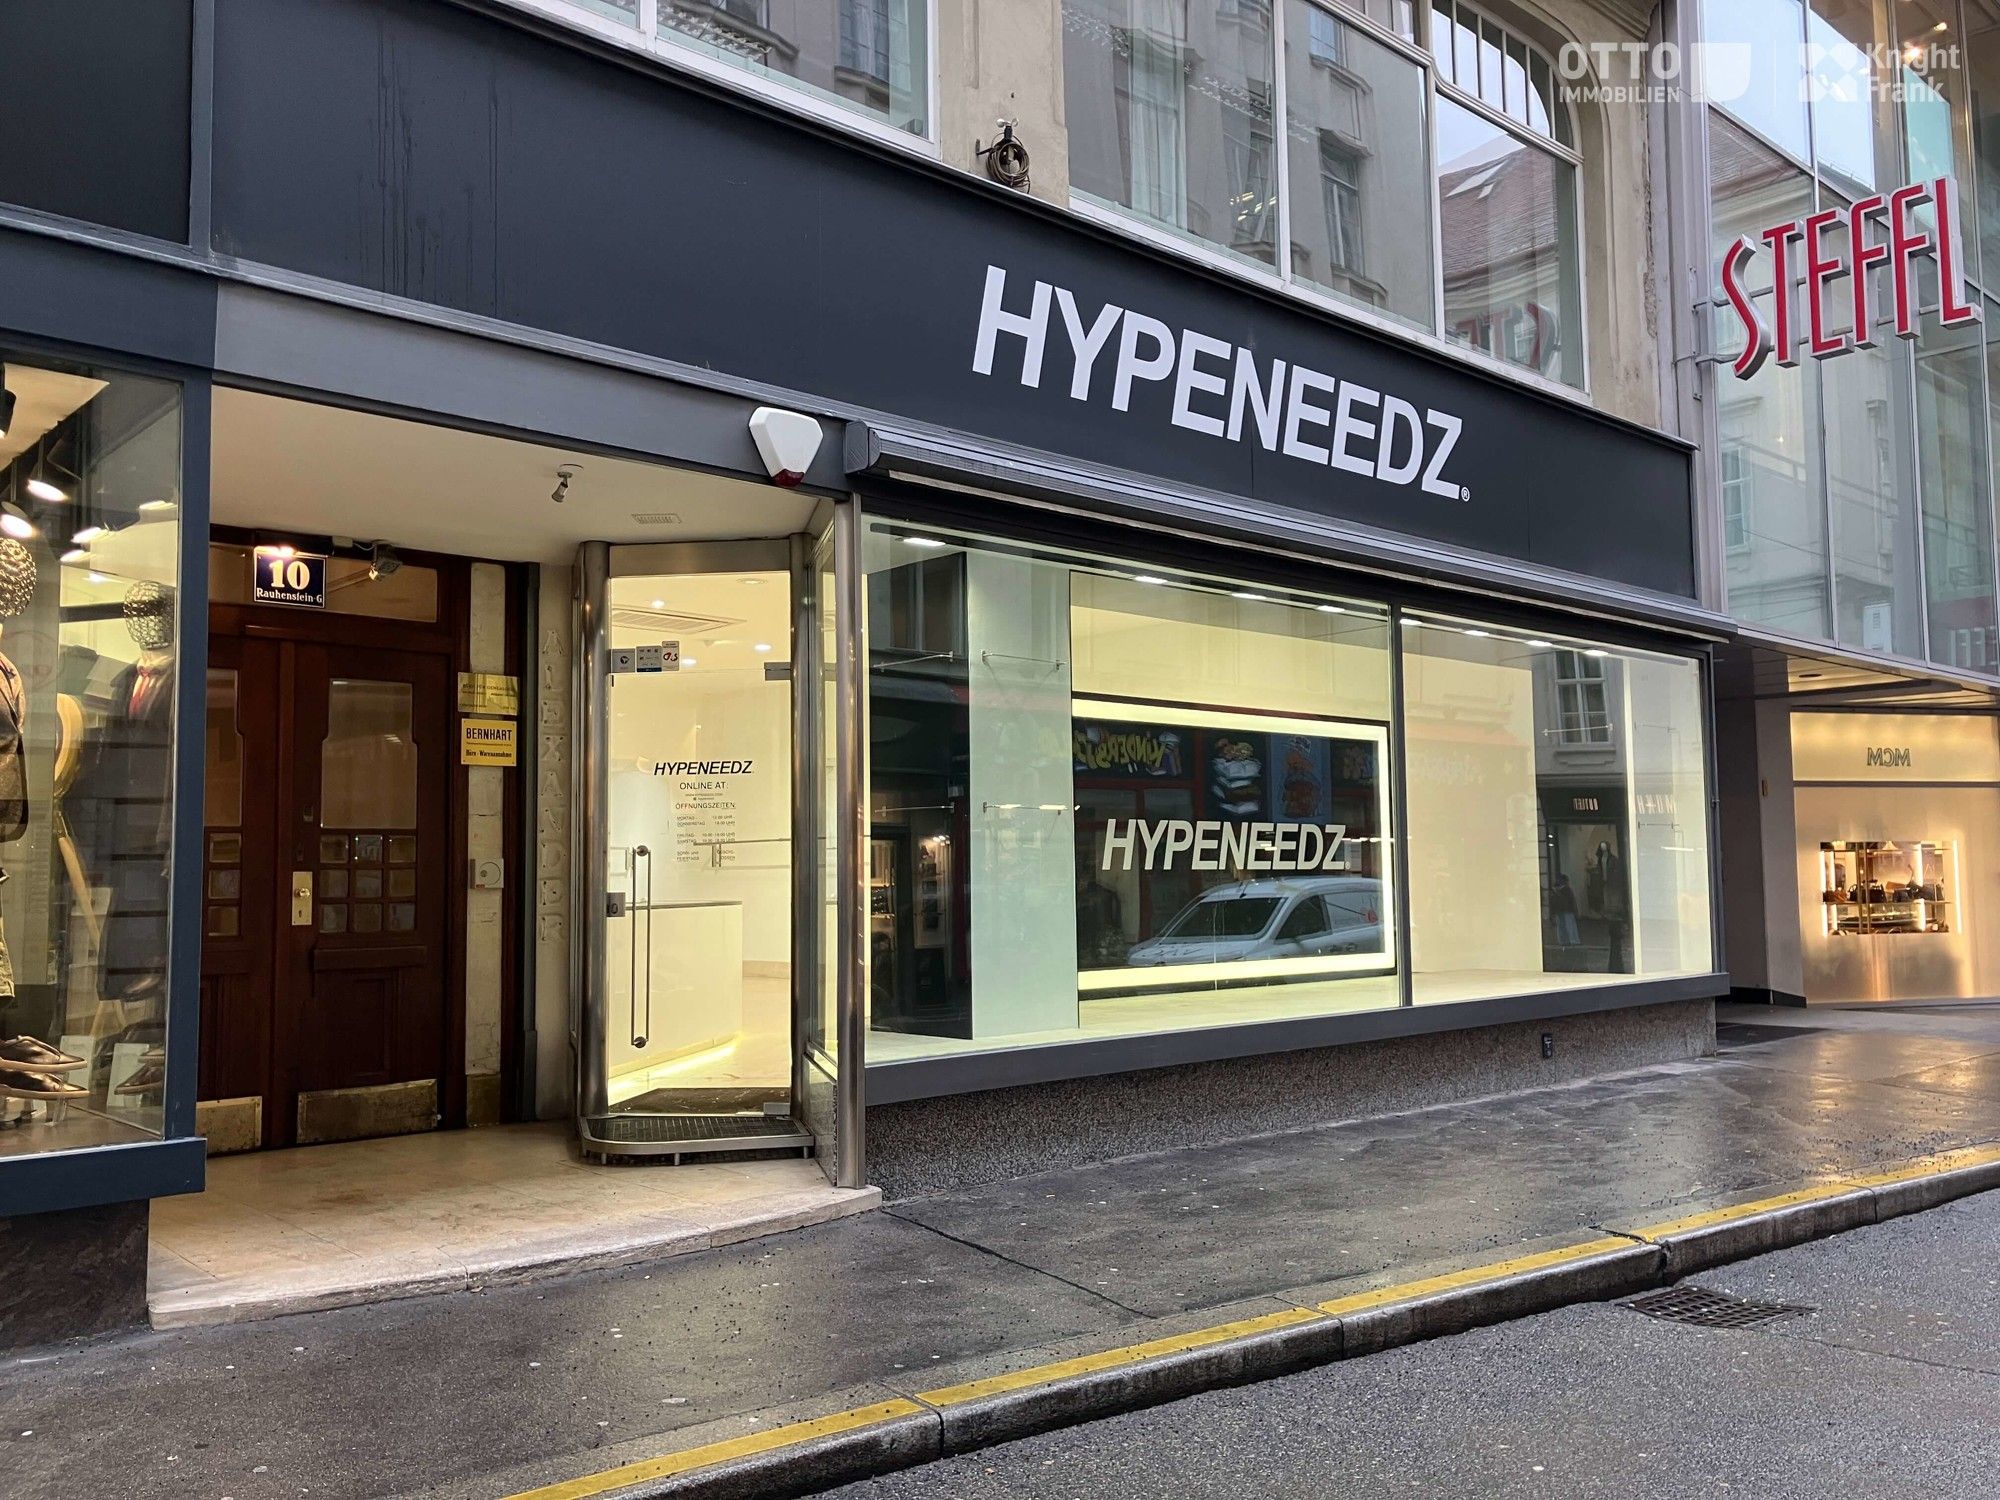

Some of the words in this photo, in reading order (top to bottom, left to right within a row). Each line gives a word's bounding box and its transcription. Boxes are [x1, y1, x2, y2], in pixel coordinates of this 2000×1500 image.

[1721, 176, 1981, 381] STEFFL
[269, 560, 310, 590] 10
[466, 727, 512, 741] BERNHART
[654, 760, 753, 776] HYPENEEDZ
[680, 782, 712, 790] ONLINE
